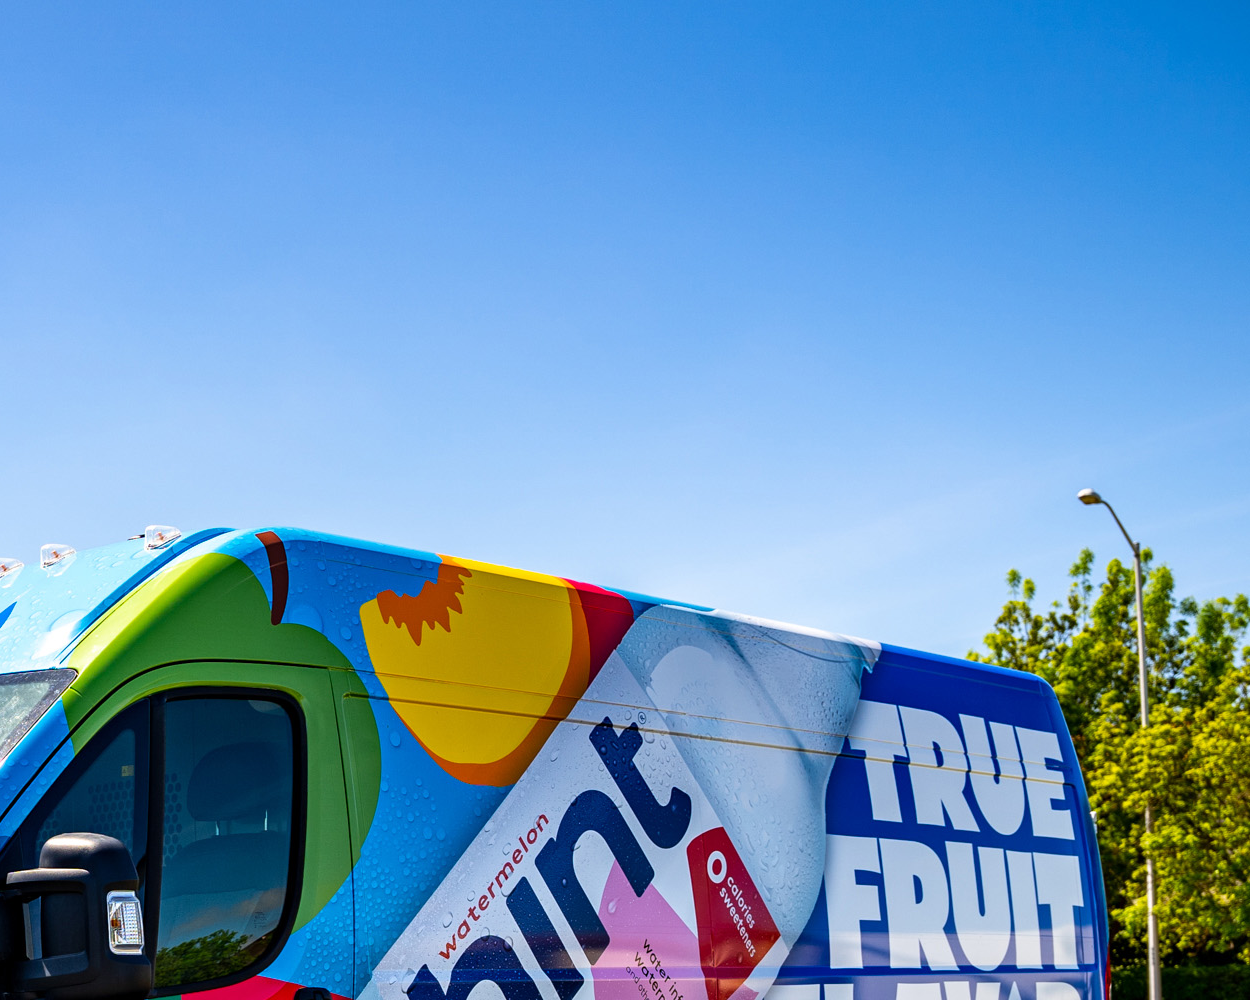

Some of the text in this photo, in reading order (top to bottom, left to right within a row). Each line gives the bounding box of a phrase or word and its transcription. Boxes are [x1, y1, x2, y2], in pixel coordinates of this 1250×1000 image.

[850, 699, 1075, 840] TRUE
[438, 813, 550, 960] watermelon
[727, 876, 756, 929] calories
[824, 834, 1083, 971] FRUIT
[719, 887, 756, 958] sweeteners
[625, 966, 640, 985] and
[643, 939, 671, 983] water
